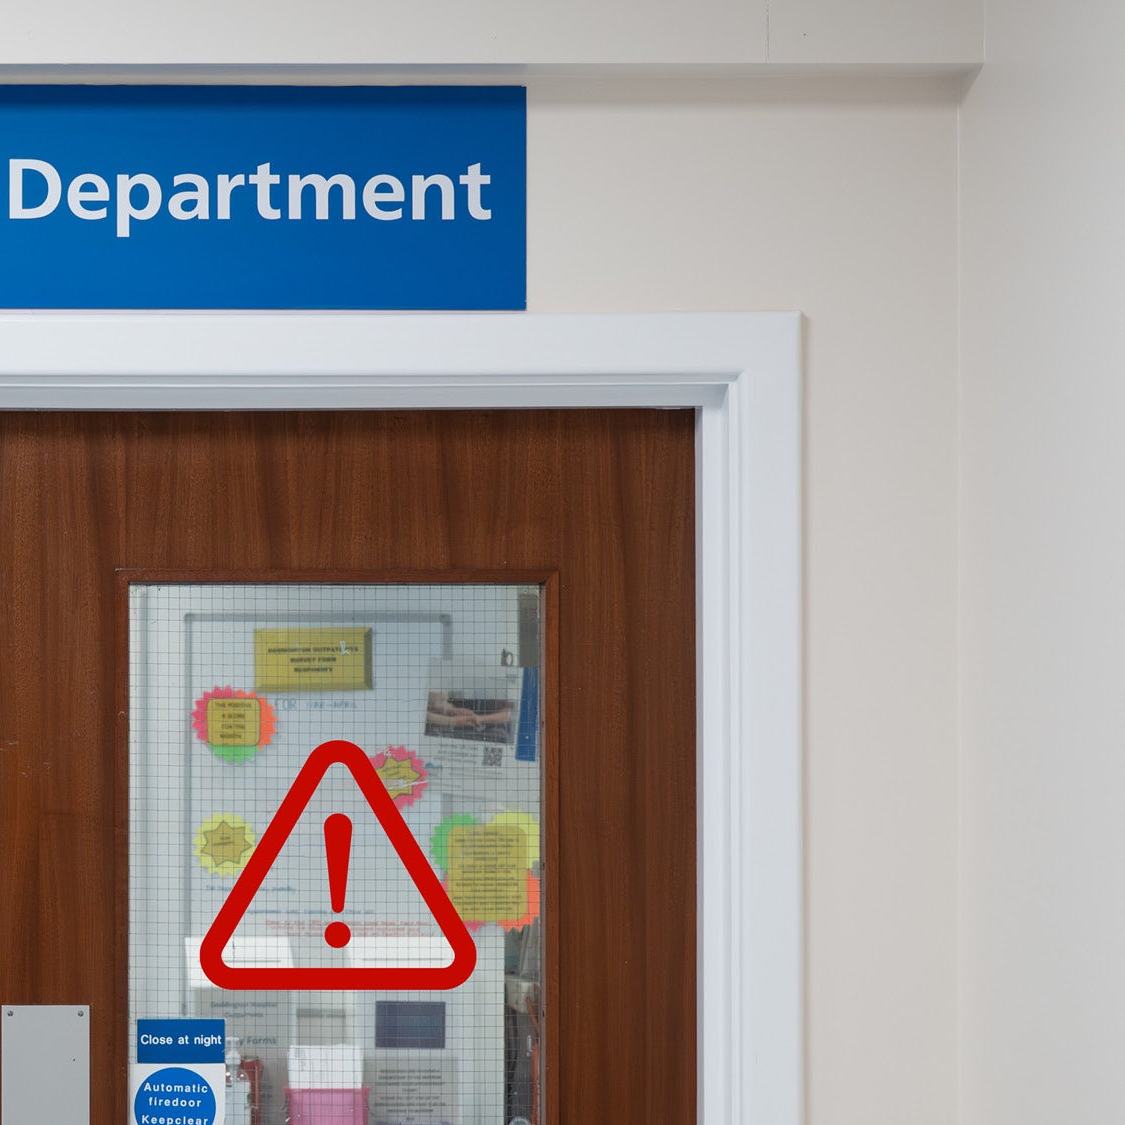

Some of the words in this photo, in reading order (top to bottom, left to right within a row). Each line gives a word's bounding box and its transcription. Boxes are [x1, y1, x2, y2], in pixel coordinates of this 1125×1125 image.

[9, 158, 492, 237] Department
[140, 1034, 173, 1045] Close
[177, 1035, 189, 1045] at
[194, 1034, 222, 1047] night
[143, 1082, 208, 1093] Automatic
[148, 1096, 202, 1107] firedoor
[141, 1114, 208, 1125] Keepclear
